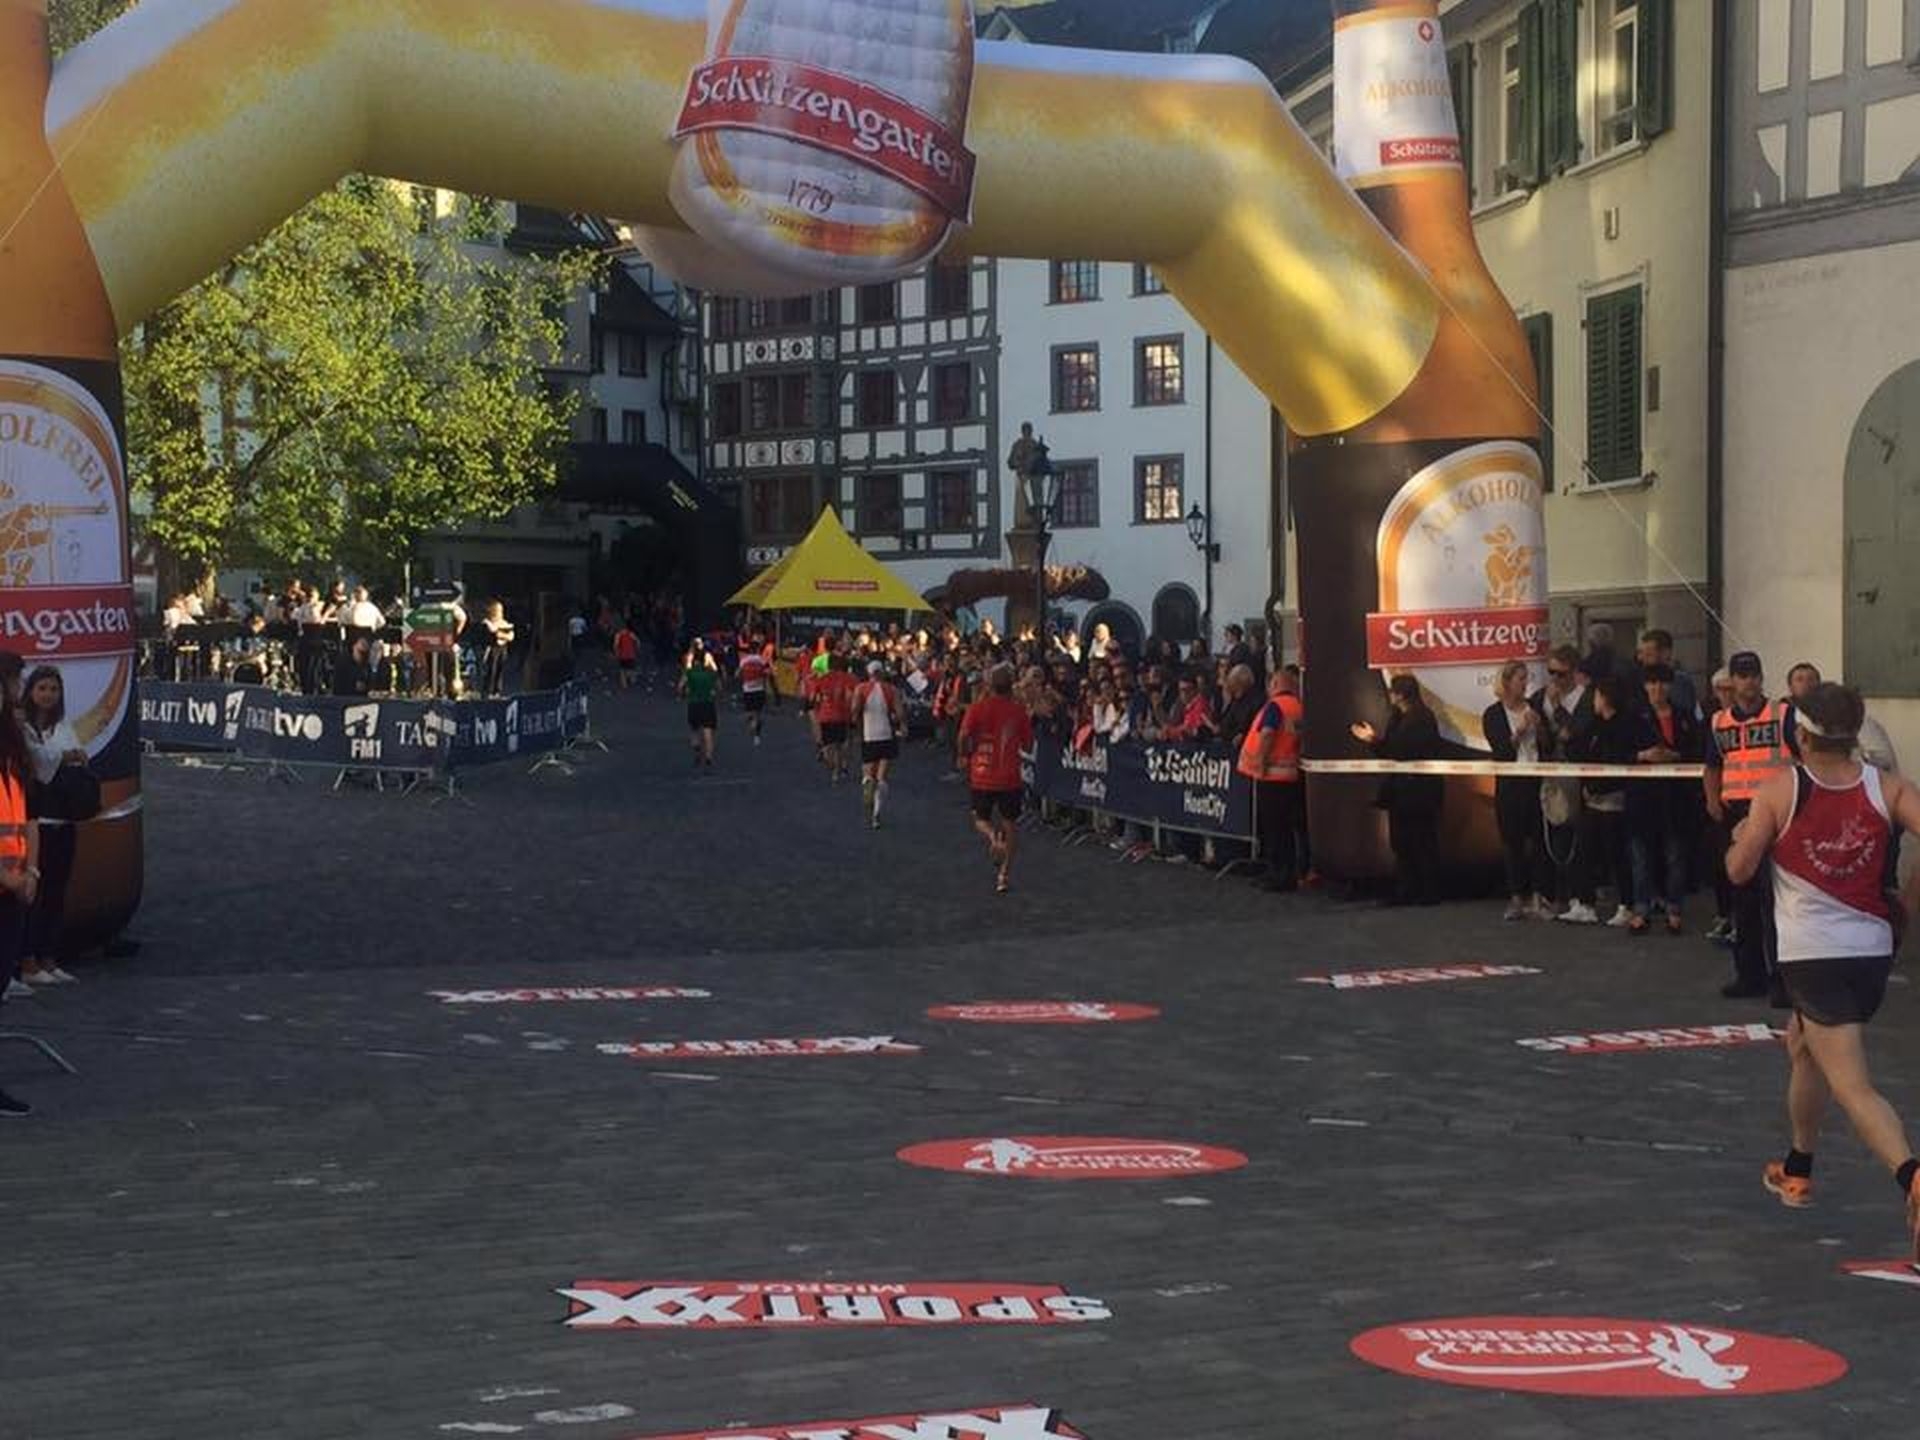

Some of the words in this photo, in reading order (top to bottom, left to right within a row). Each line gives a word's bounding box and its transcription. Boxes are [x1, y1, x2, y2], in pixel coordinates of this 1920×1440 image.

[788, 177, 833, 213] 1779
[188, 698, 217, 727] tvo
[275, 707, 323, 740] tvo
[351, 739, 382, 759] FM1
[736, 1283, 906, 1294] MIGROS
[556, 1286, 1112, 1326] SPORTXX
